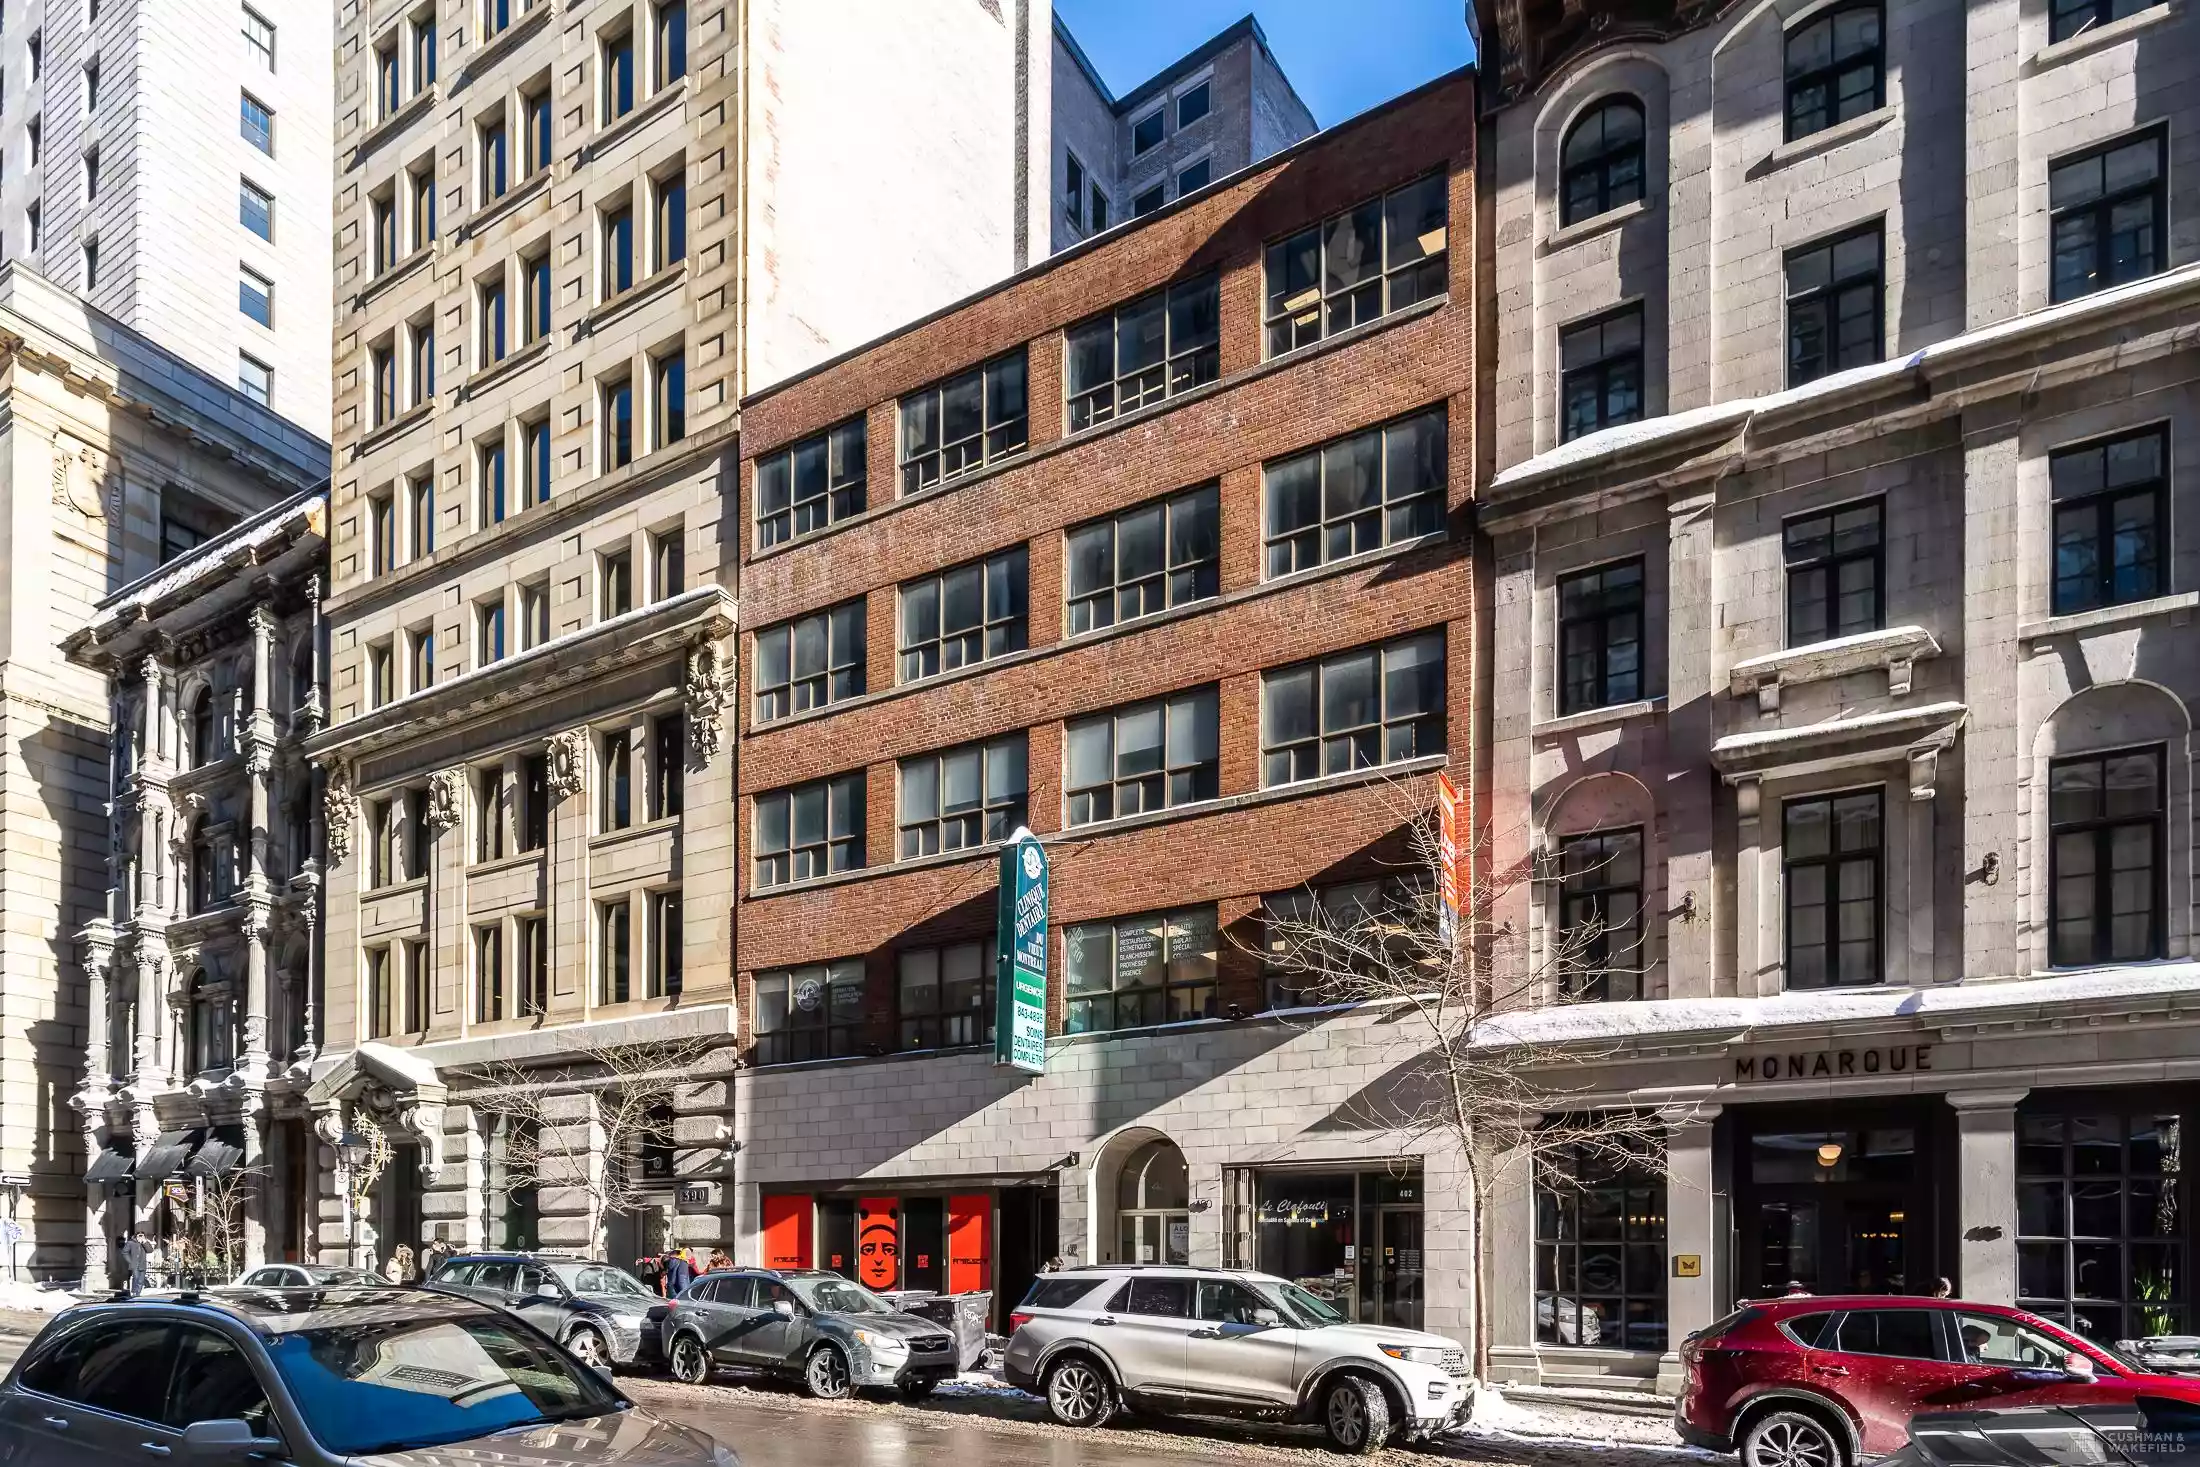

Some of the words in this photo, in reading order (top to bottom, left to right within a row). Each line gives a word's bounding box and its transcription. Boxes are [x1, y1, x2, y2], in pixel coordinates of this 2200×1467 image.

[1017, 882, 1045, 917] CLINIQUE
[1016, 904, 1046, 939] DENTAIRE
[1119, 968, 1142, 978] URGENCE
[1016, 981, 1044, 999] URGENCE
[1026, 1026, 1044, 1041] SOINS
[1014, 1034, 1043, 1053] DENTAIRES
[1013, 1048, 1043, 1066] COMPLETS
[1735, 1045, 1932, 1080] MONARQUE
[682, 1189, 705, 1202] 390
[1399, 1189, 1413, 1198] 402
[1259, 1199, 1274, 1212] Le
